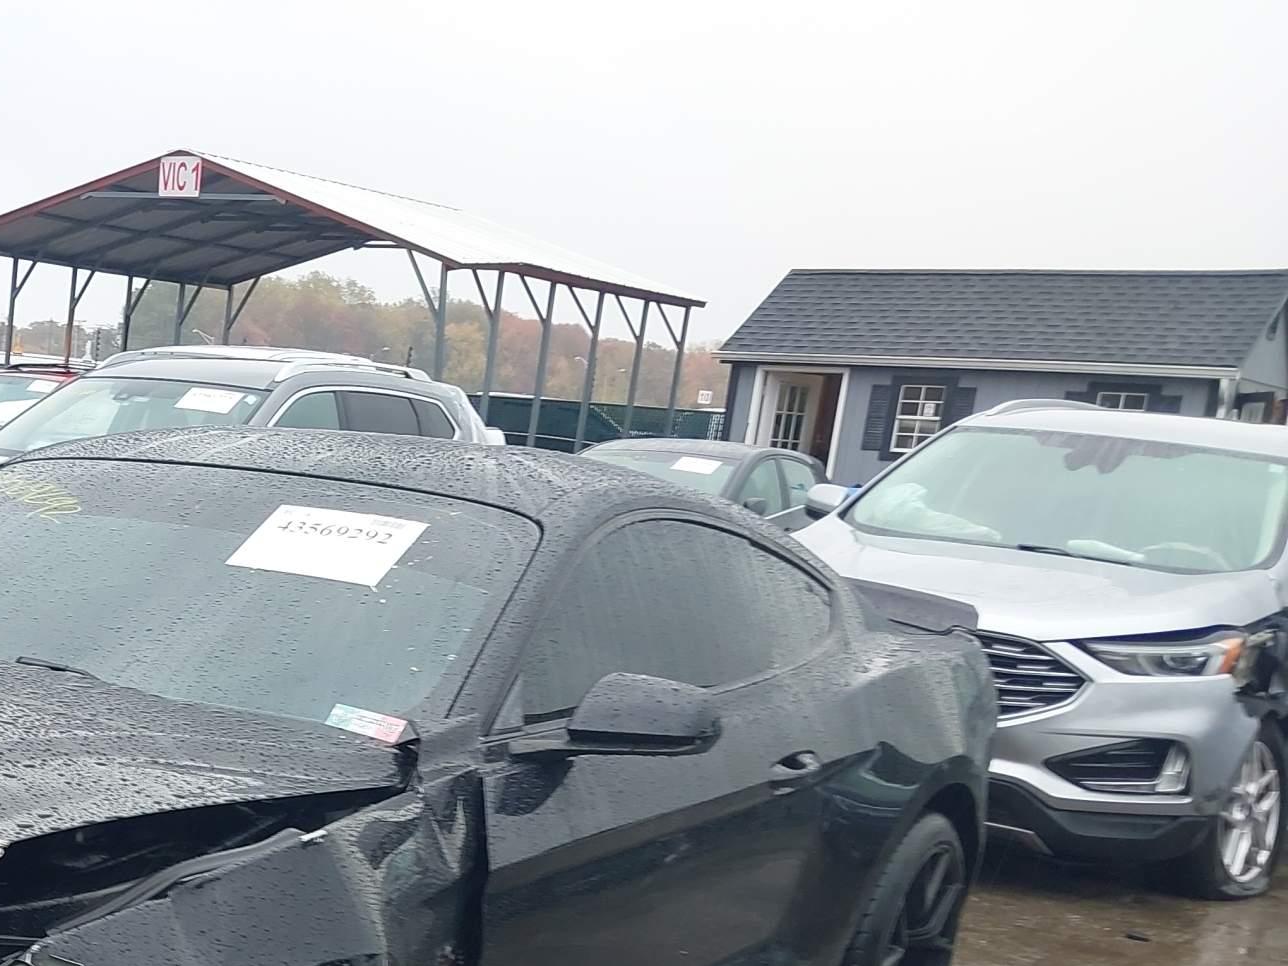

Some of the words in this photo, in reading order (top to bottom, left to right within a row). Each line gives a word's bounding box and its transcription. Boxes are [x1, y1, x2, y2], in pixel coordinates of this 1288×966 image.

[162, 161, 187, 191] VIC
[191, 161, 200, 191] 1
[277, 520, 394, 545] 43569292
